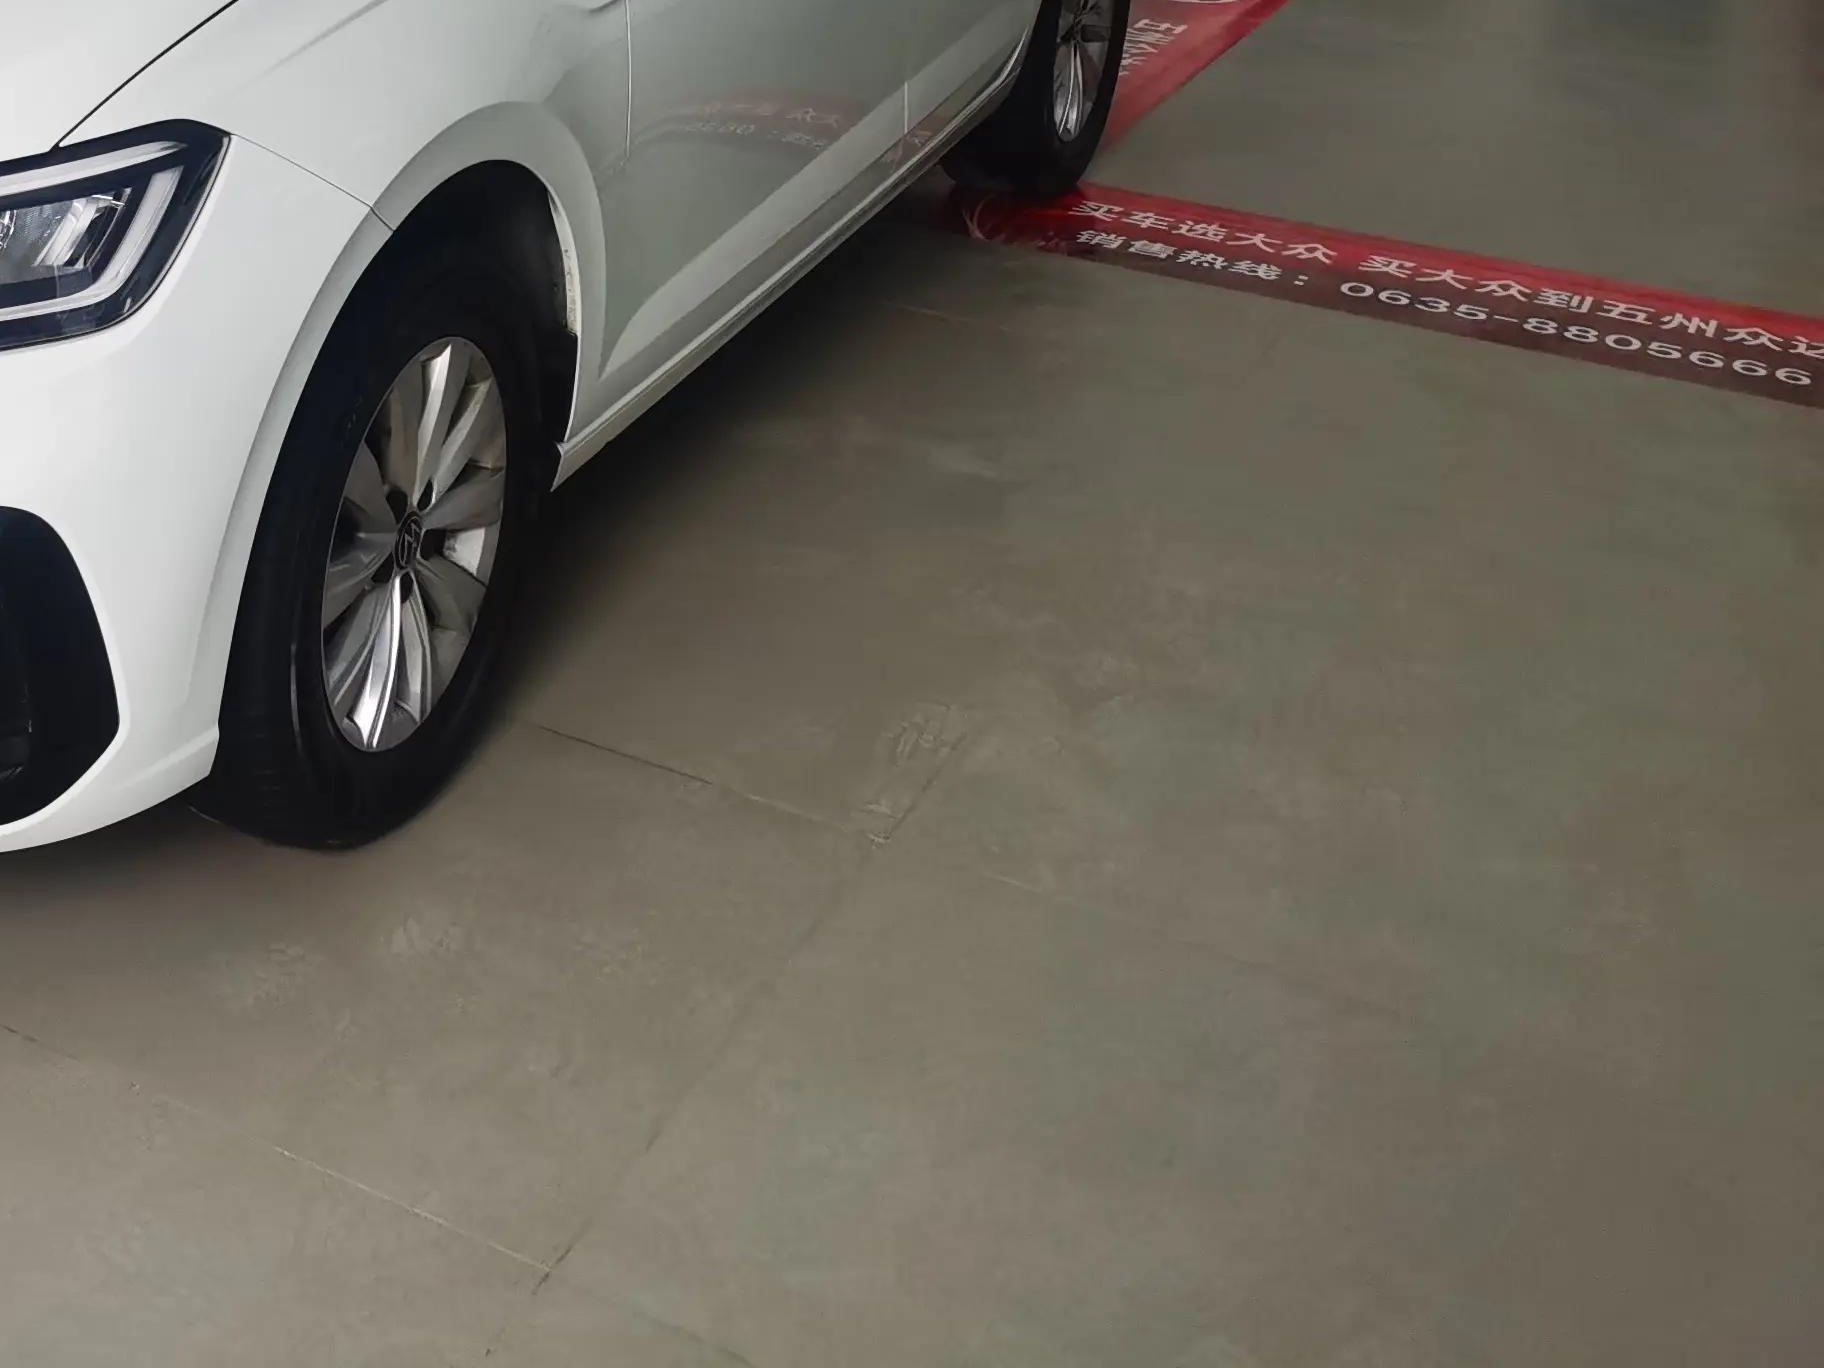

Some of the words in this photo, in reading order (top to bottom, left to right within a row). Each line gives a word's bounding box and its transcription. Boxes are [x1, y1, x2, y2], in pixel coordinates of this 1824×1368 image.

[1069, 200, 1339, 265] 买车选大众
